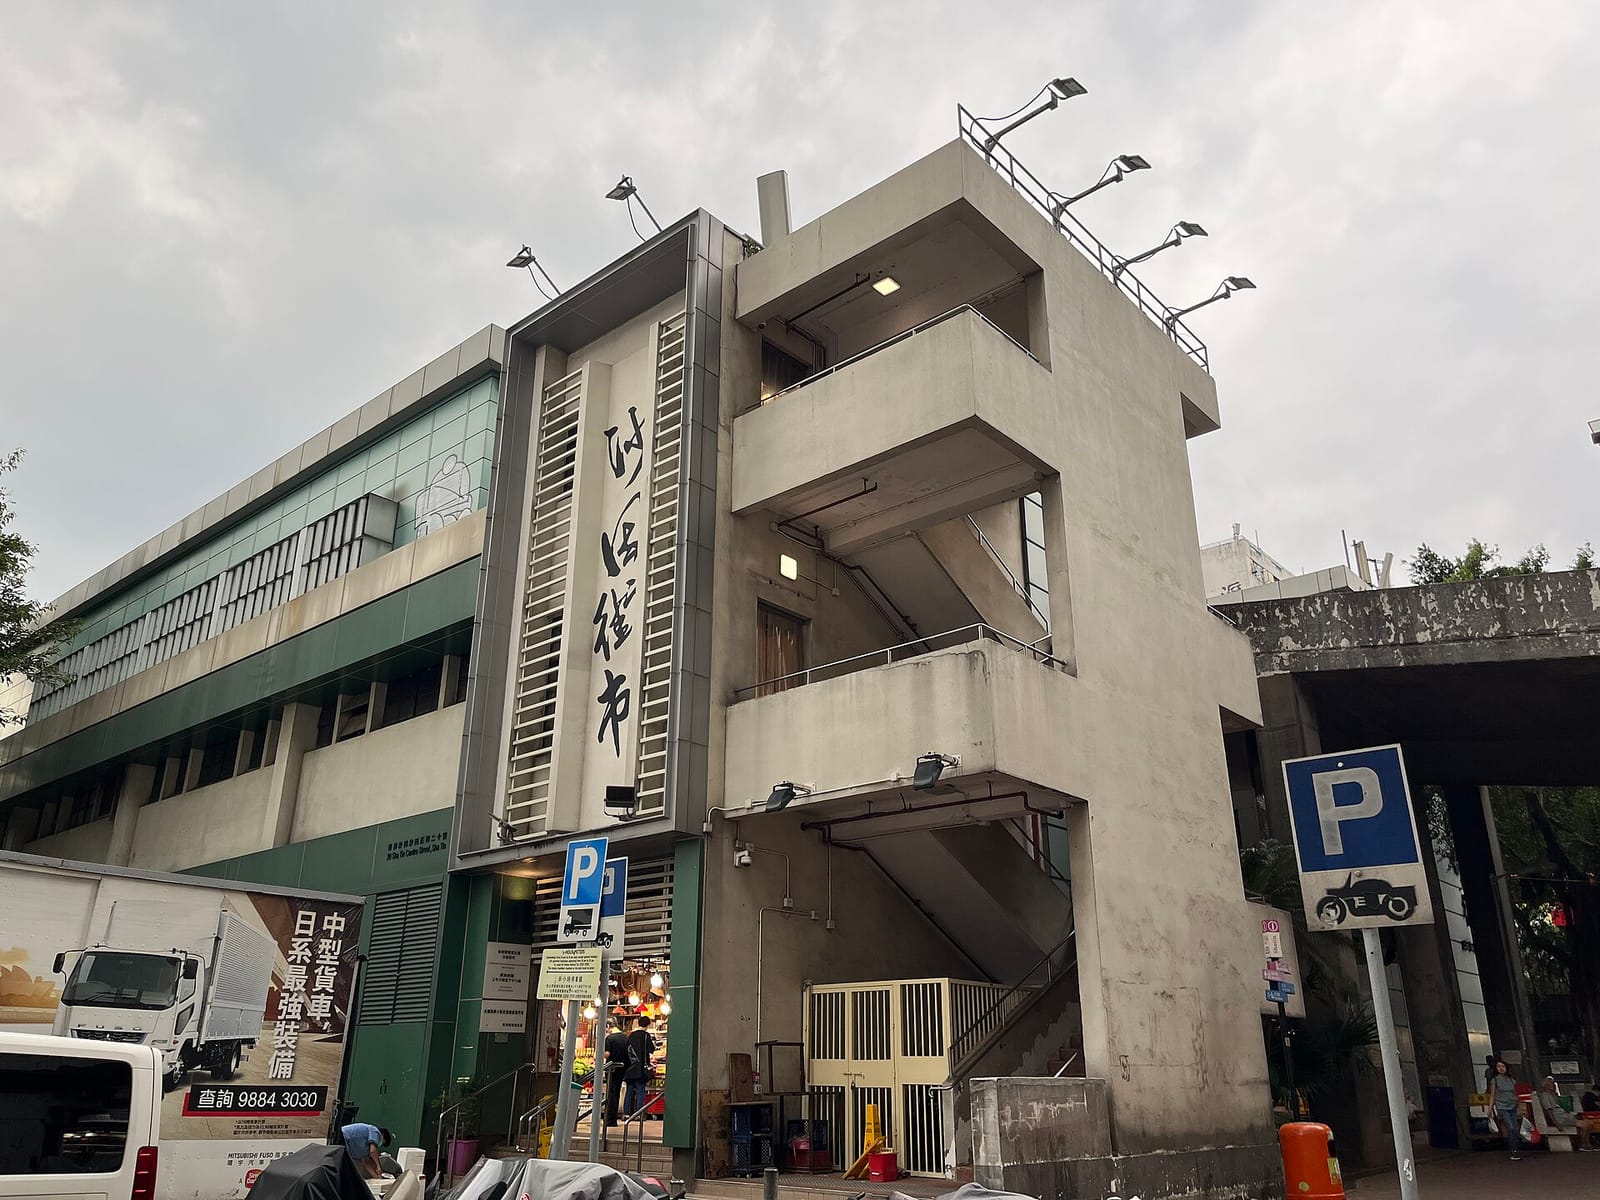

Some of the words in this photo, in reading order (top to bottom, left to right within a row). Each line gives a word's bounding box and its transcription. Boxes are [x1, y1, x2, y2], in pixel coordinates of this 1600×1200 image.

[1311, 766, 1384, 857] P
[569, 846, 598, 900] P
[268, 910, 317, 1080] 日系最強裝備
[196, 1089, 234, 1109] 查詢
[237, 1090, 277, 1109] 9884
[280, 1090, 318, 1108] 3030
